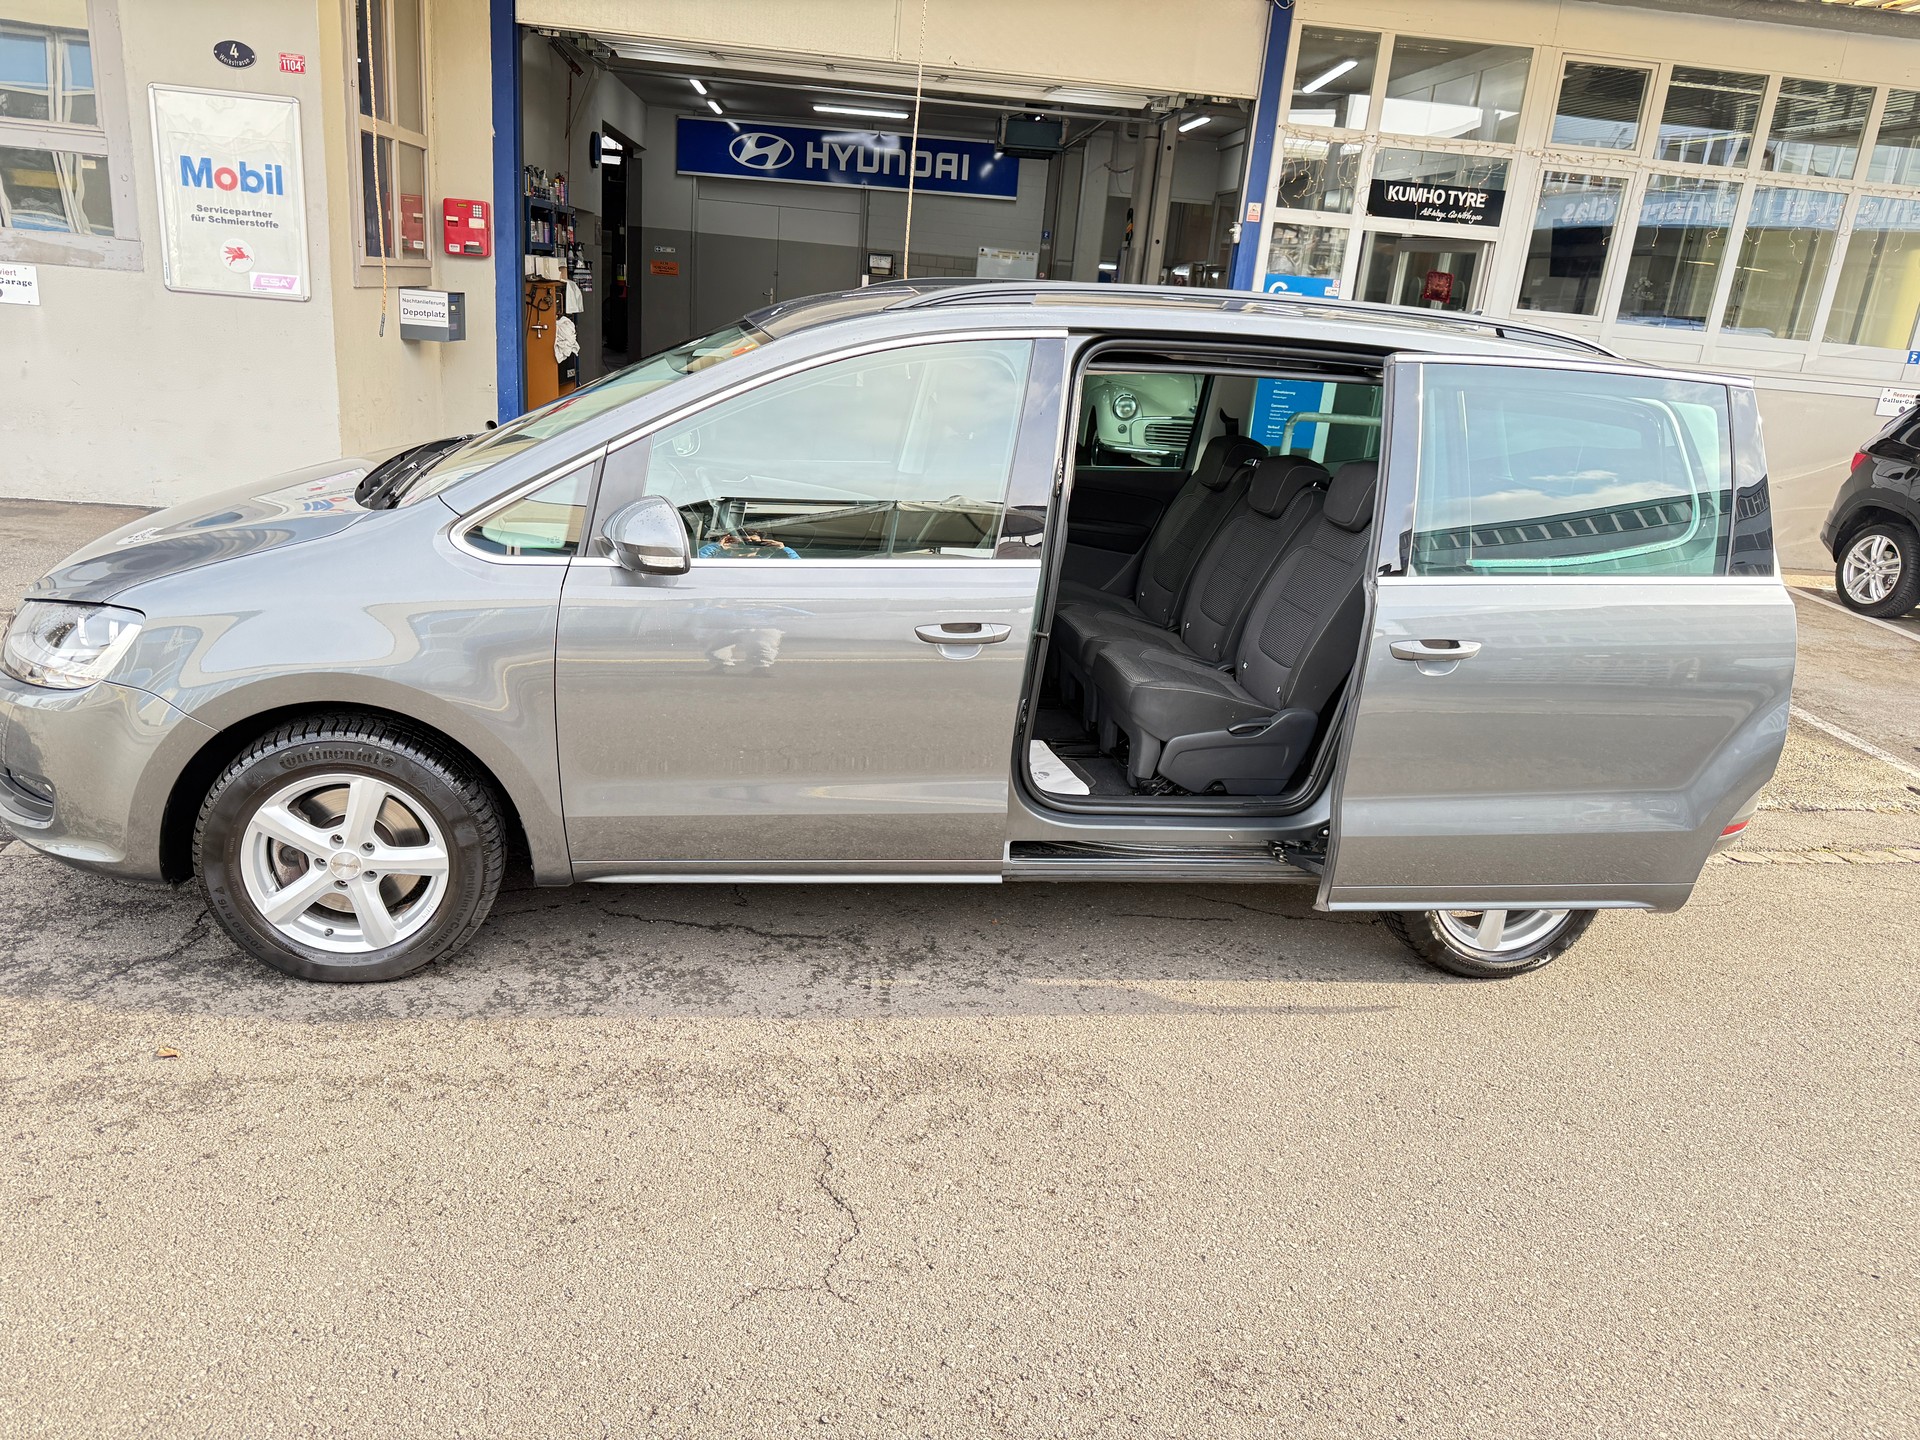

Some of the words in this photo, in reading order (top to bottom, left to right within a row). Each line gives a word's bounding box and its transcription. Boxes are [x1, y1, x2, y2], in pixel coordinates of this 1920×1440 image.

[229, 43, 239, 59] 4
[281, 59, 302, 72] 1104
[806, 141, 970, 181] HYUNDAI
[179, 155, 284, 196] Mobil
[1387, 185, 1446, 205] KUMHO
[1447, 190, 1488, 208] TYRE
[196, 204, 273, 219] Servicepartner
[191, 214, 205, 223] für
[208, 216, 280, 229] Schmierstoffe
[402, 298, 446, 307] Nachtanlieferung
[402, 308, 446, 318] Depotplatz
